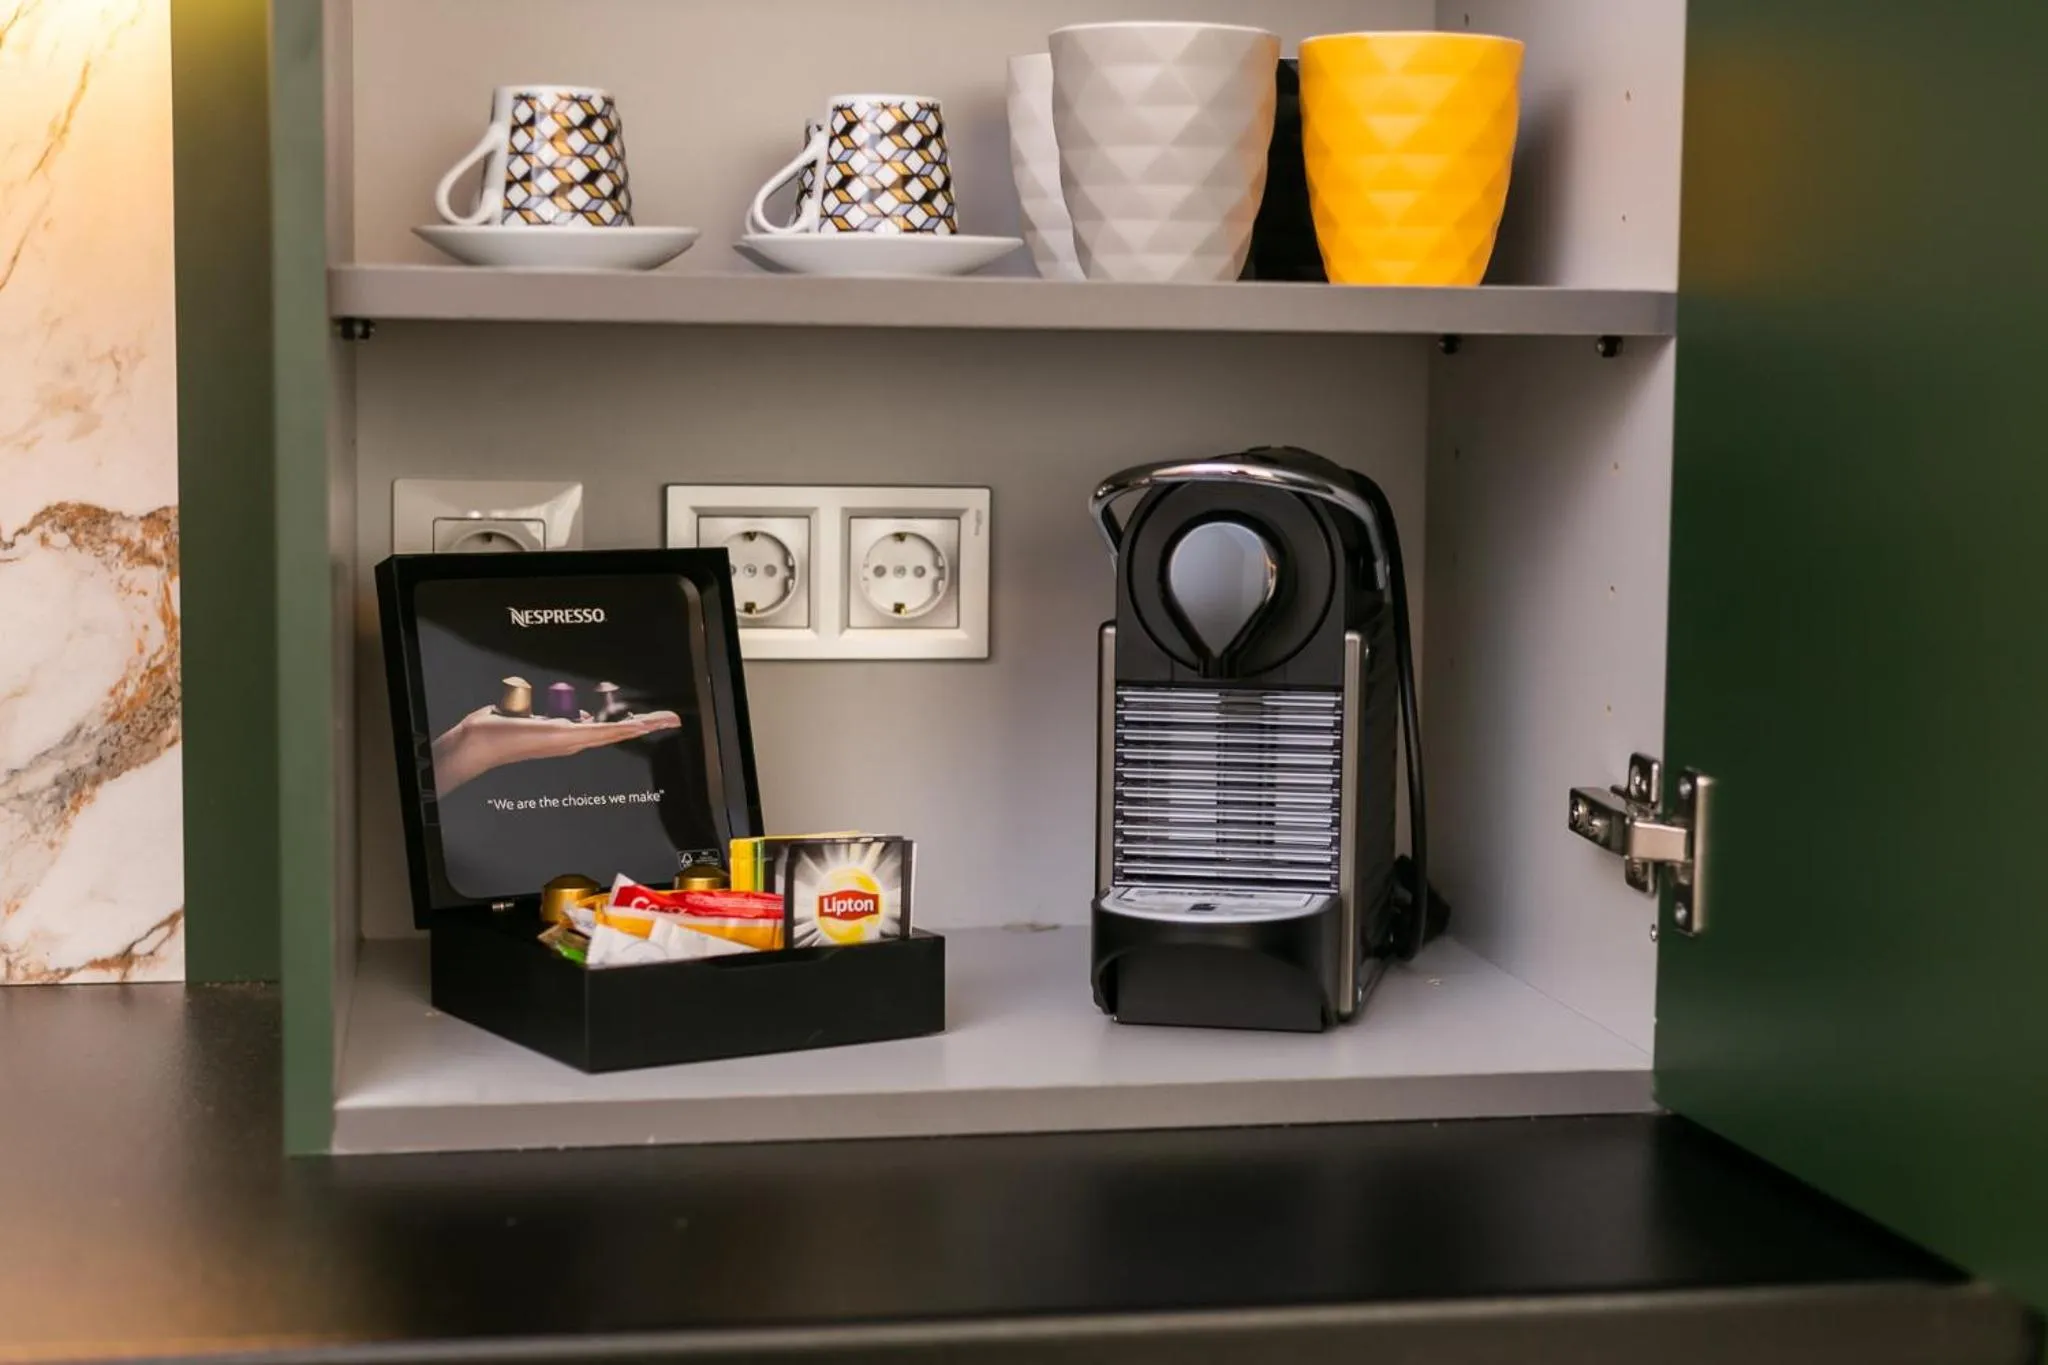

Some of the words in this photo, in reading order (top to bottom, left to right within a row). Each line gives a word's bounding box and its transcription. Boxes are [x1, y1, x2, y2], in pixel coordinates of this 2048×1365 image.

[506, 607, 606, 627] NESPRESSO
[516, 799, 537, 810] are
[539, 794, 560, 808] the
[562, 793, 607, 807] choices
[608, 794, 626, 804] we
[823, 896, 875, 916] Lipton
